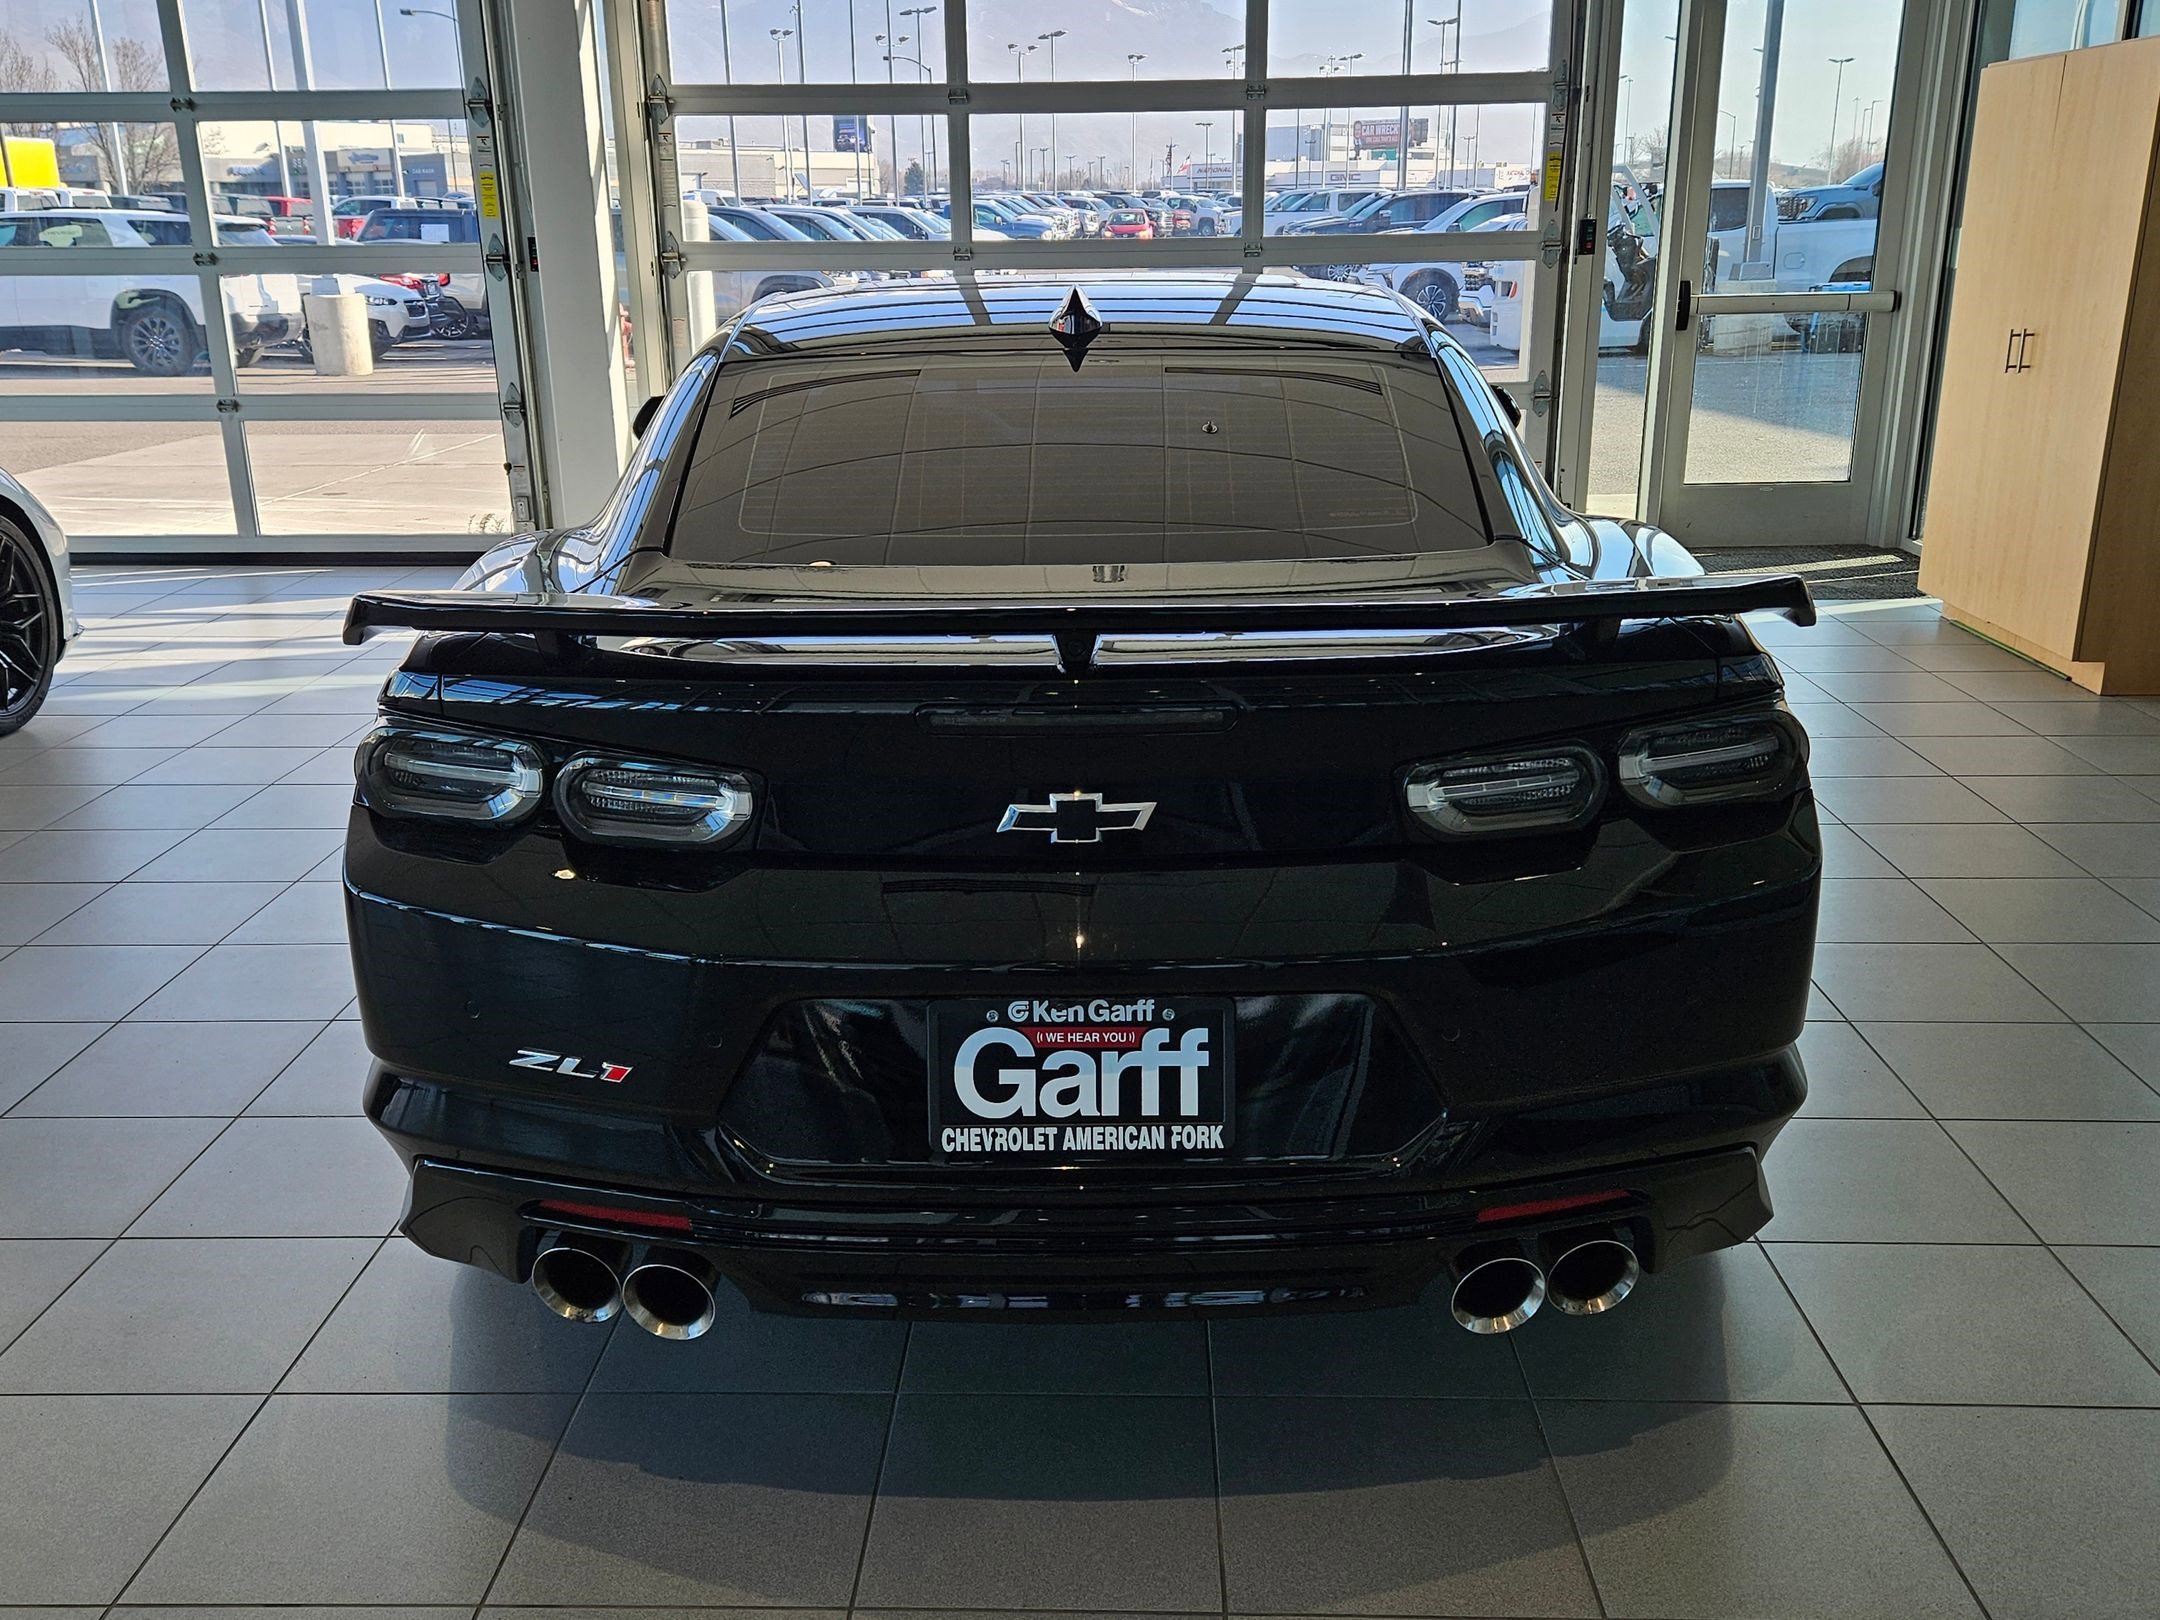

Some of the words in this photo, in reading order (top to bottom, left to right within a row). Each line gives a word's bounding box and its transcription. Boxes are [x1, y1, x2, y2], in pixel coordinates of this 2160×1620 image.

[1362, 125, 1374, 136] CAR
[1330, 173, 1361, 181] GMC
[1033, 1000, 1084, 1022] Ken
[1088, 999, 1155, 1022] Garff
[1046, 1032, 1065, 1043] WE
[1067, 1032, 1100, 1043] HEAR
[1102, 1032, 1127, 1043] YOU
[509, 1048, 634, 1083] ZL1
[954, 1027, 1209, 1118] Garff
[941, 1127, 1058, 1152] CHEVROLET
[1062, 1125, 1165, 1151] AMERICAN
[1171, 1125, 1224, 1149] FORK
